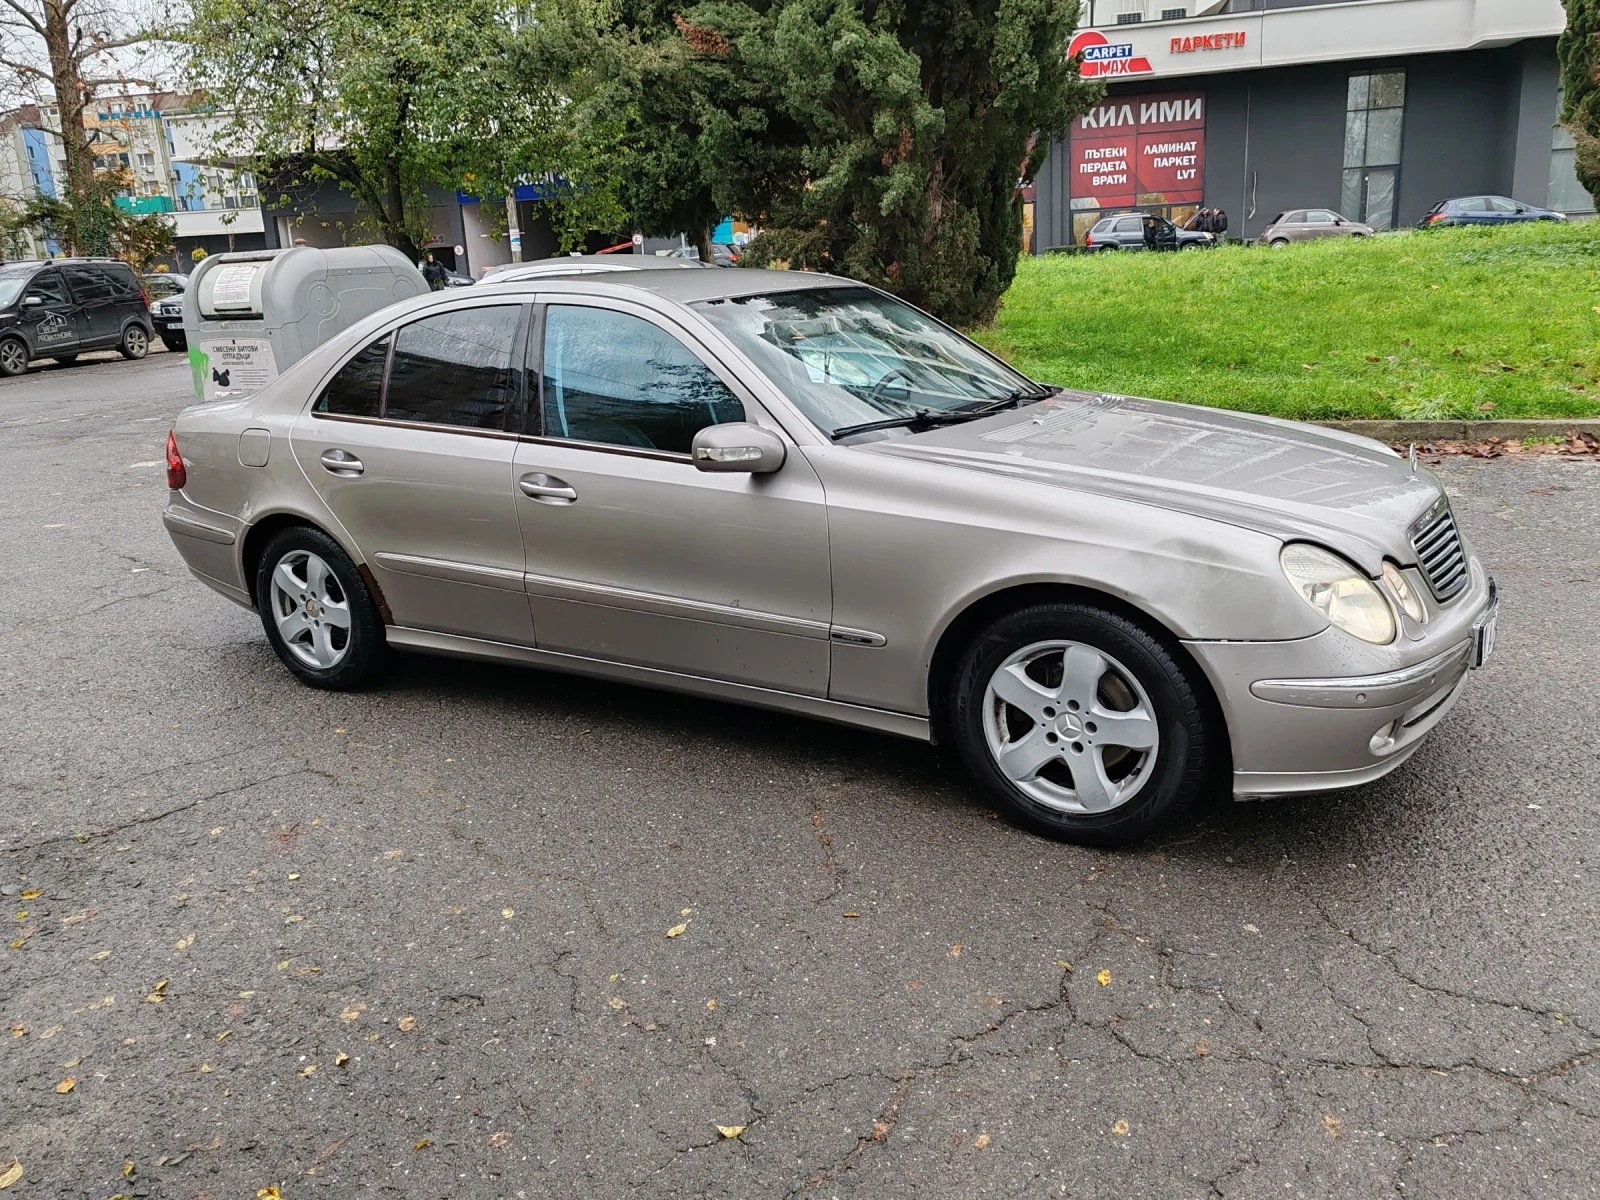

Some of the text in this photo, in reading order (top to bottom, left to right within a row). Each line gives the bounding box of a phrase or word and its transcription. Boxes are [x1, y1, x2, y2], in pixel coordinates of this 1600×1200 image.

[1170, 31, 1246, 52] ПАРКЕТИ
[1084, 45, 1131, 59] CARPET
[1100, 59, 1129, 75] MAX
[1085, 147, 1127, 159] ПЪТЕКИ
[1143, 141, 1197, 155] ЛАМИНАТ
[1080, 161, 1127, 173] ПЕРДЕТА
[1153, 155, 1197, 168] ПАРКЕТ
[1092, 174, 1127, 186] ВРАТИ
[1177, 169, 1197, 180] LVT
